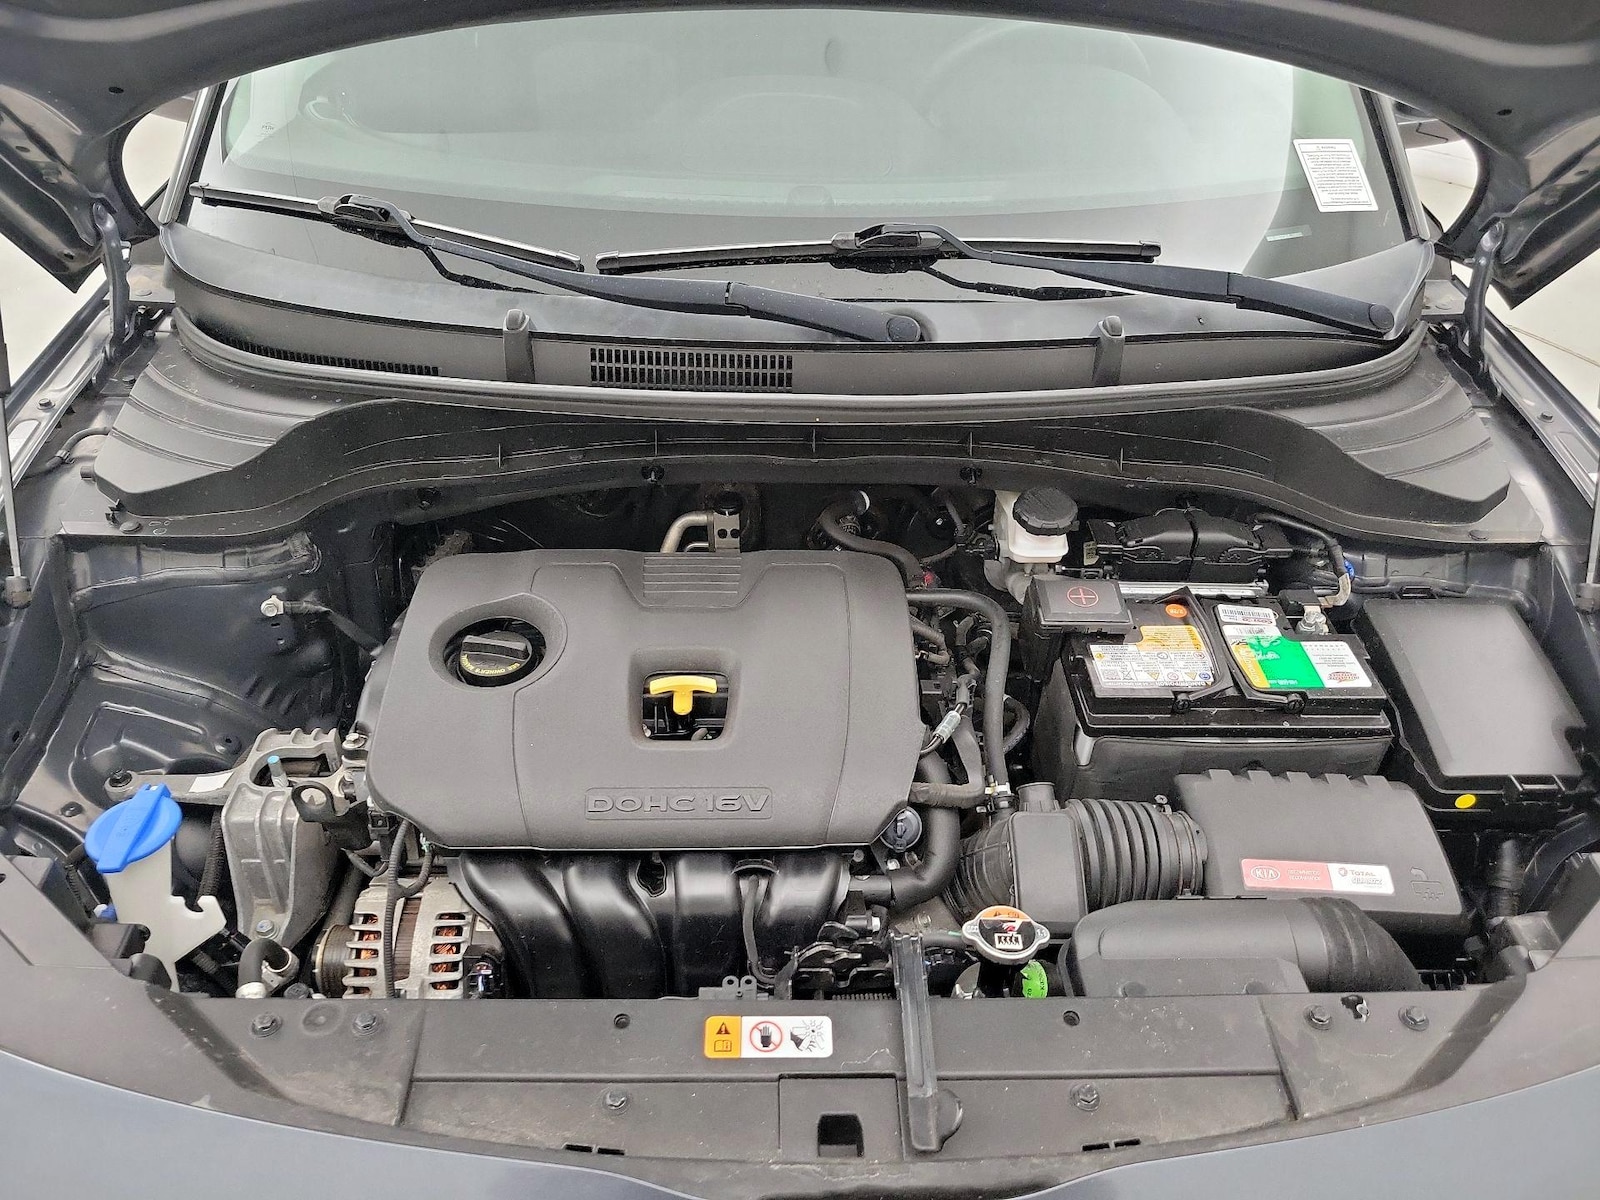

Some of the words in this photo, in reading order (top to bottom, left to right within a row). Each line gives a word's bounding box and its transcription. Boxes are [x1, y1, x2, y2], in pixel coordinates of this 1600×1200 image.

[461, 653, 475, 671] MANUAL
[587, 795, 696, 812] DOHC
[705, 794, 770, 812] 16V
[1254, 867, 1277, 879] KIA
[1350, 869, 1376, 877] TOTAL
